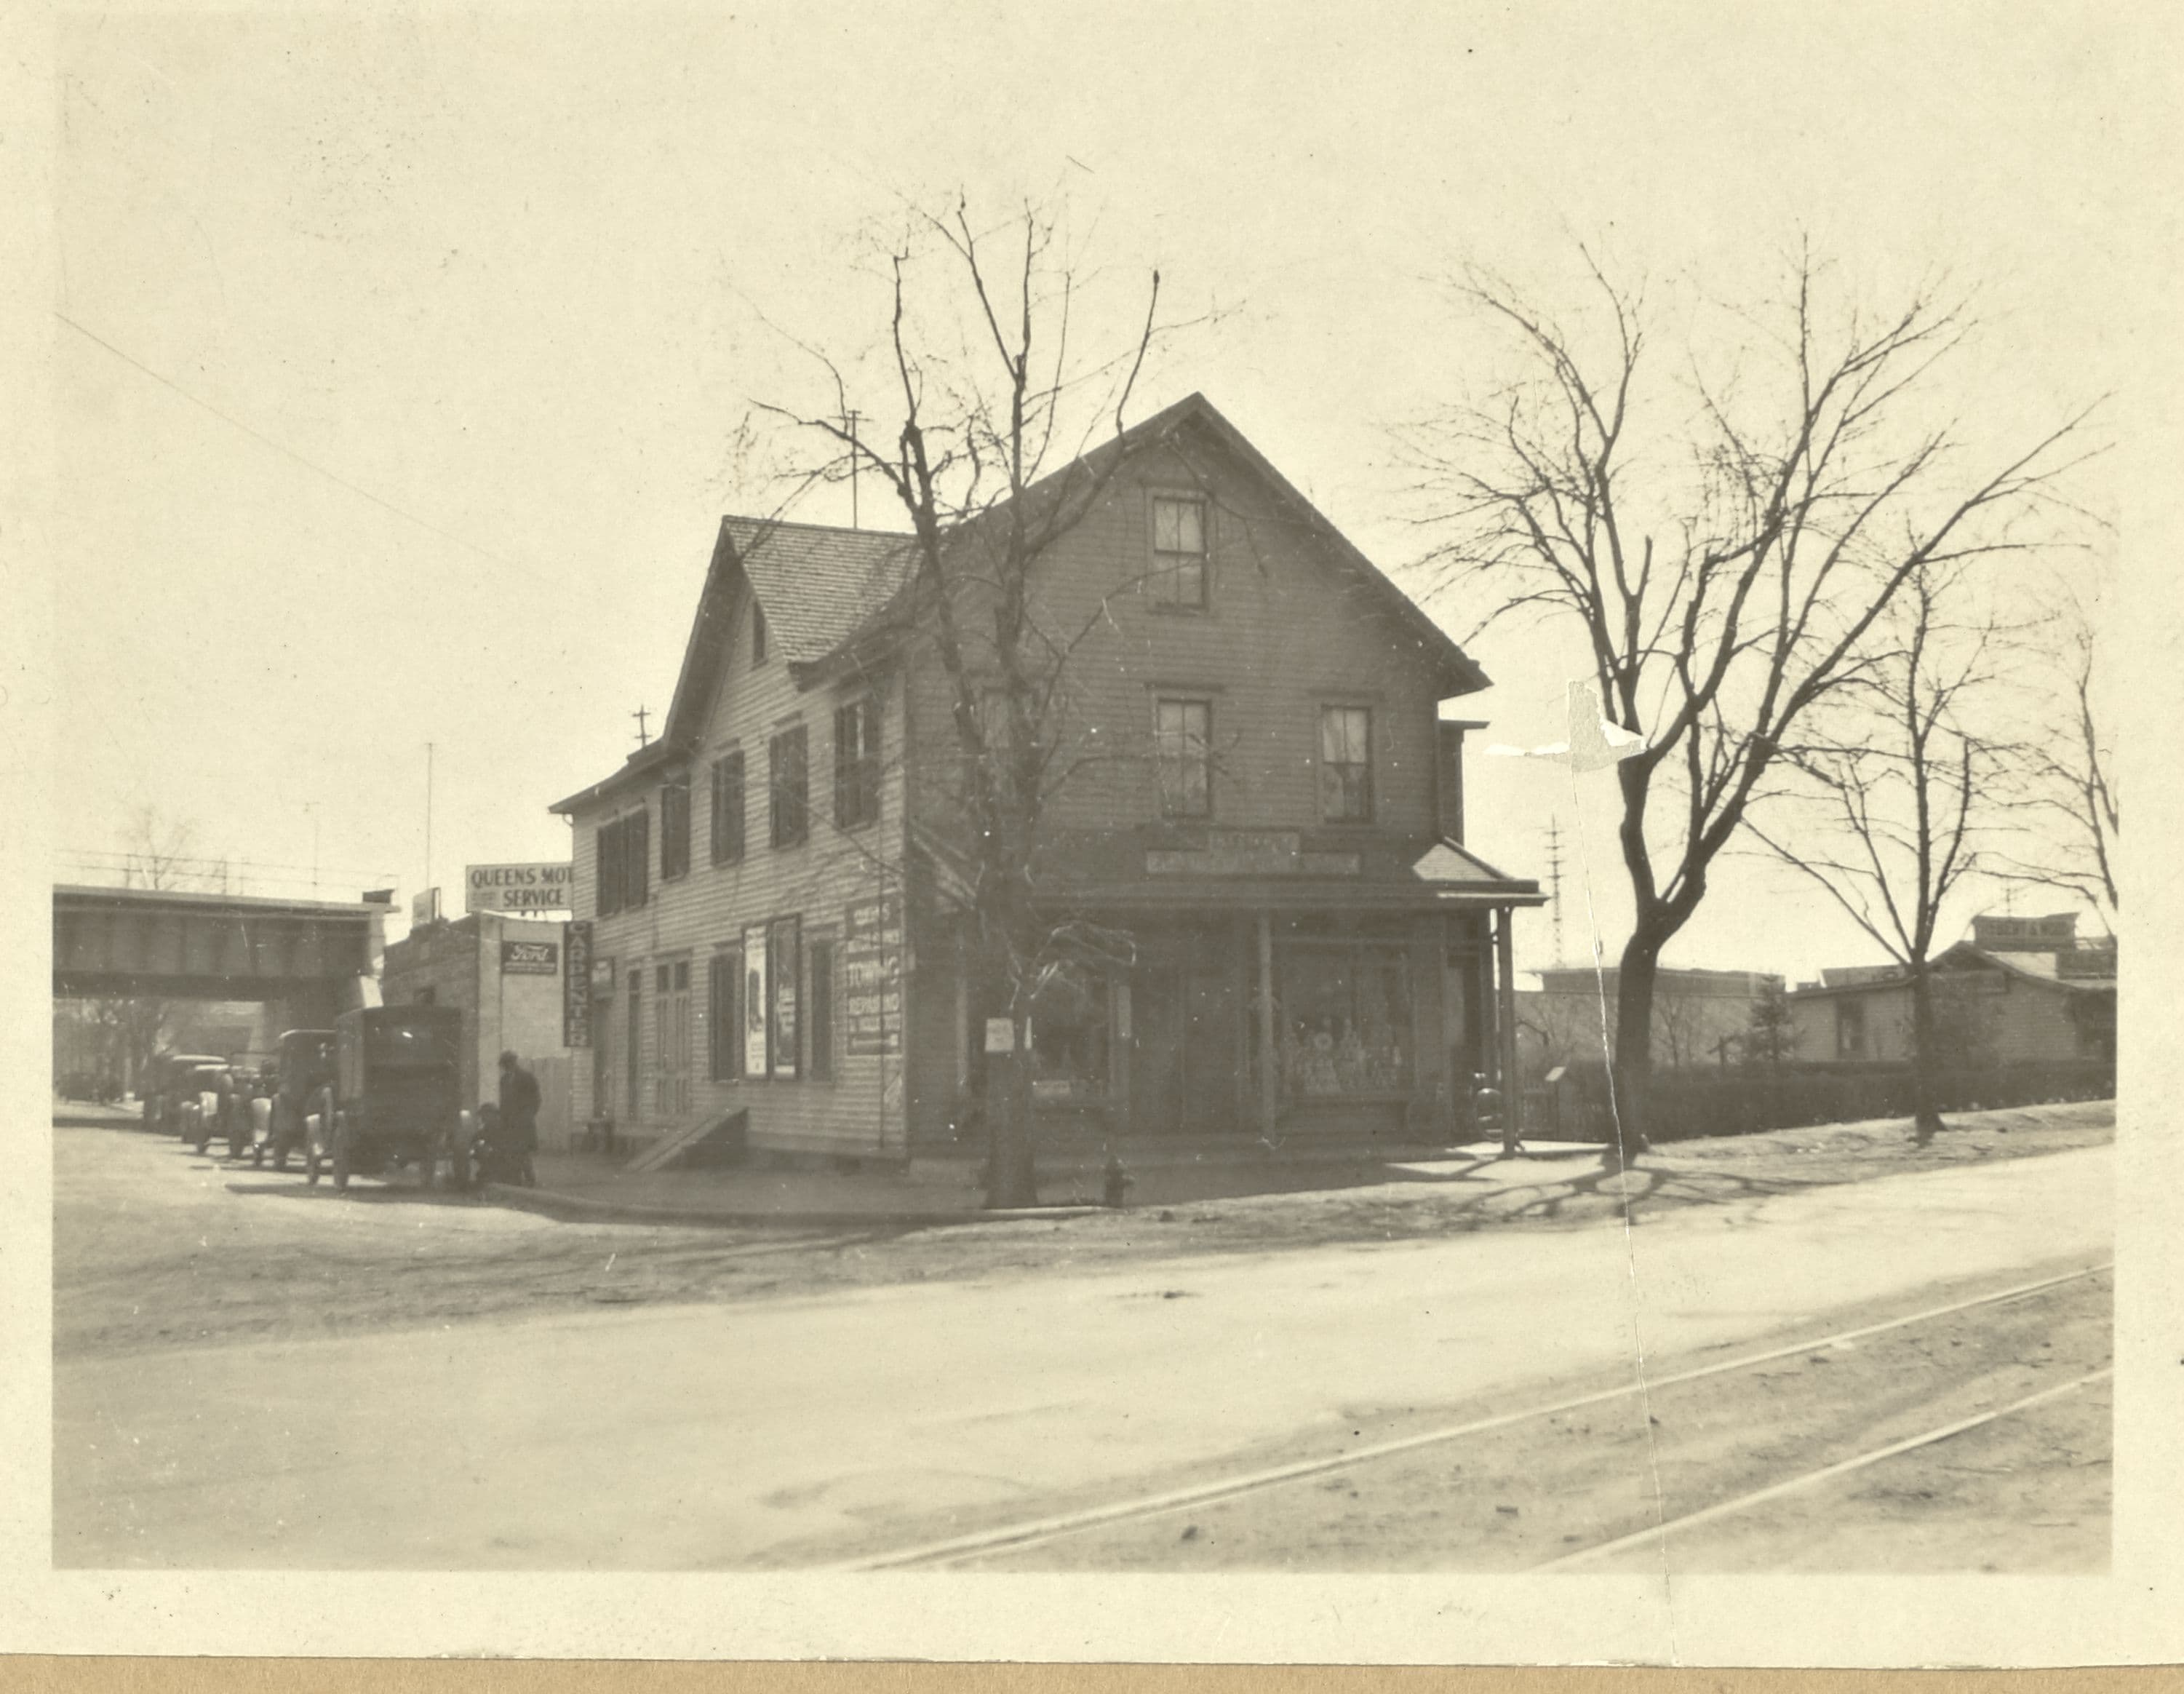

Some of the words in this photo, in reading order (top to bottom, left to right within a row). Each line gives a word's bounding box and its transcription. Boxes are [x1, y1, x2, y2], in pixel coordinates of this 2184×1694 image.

[471, 867, 537, 888] QUEENS
[503, 888, 564, 907] SERVICE
[510, 944, 550, 962] Ford
[567, 922, 588, 1046] CARPENTER
